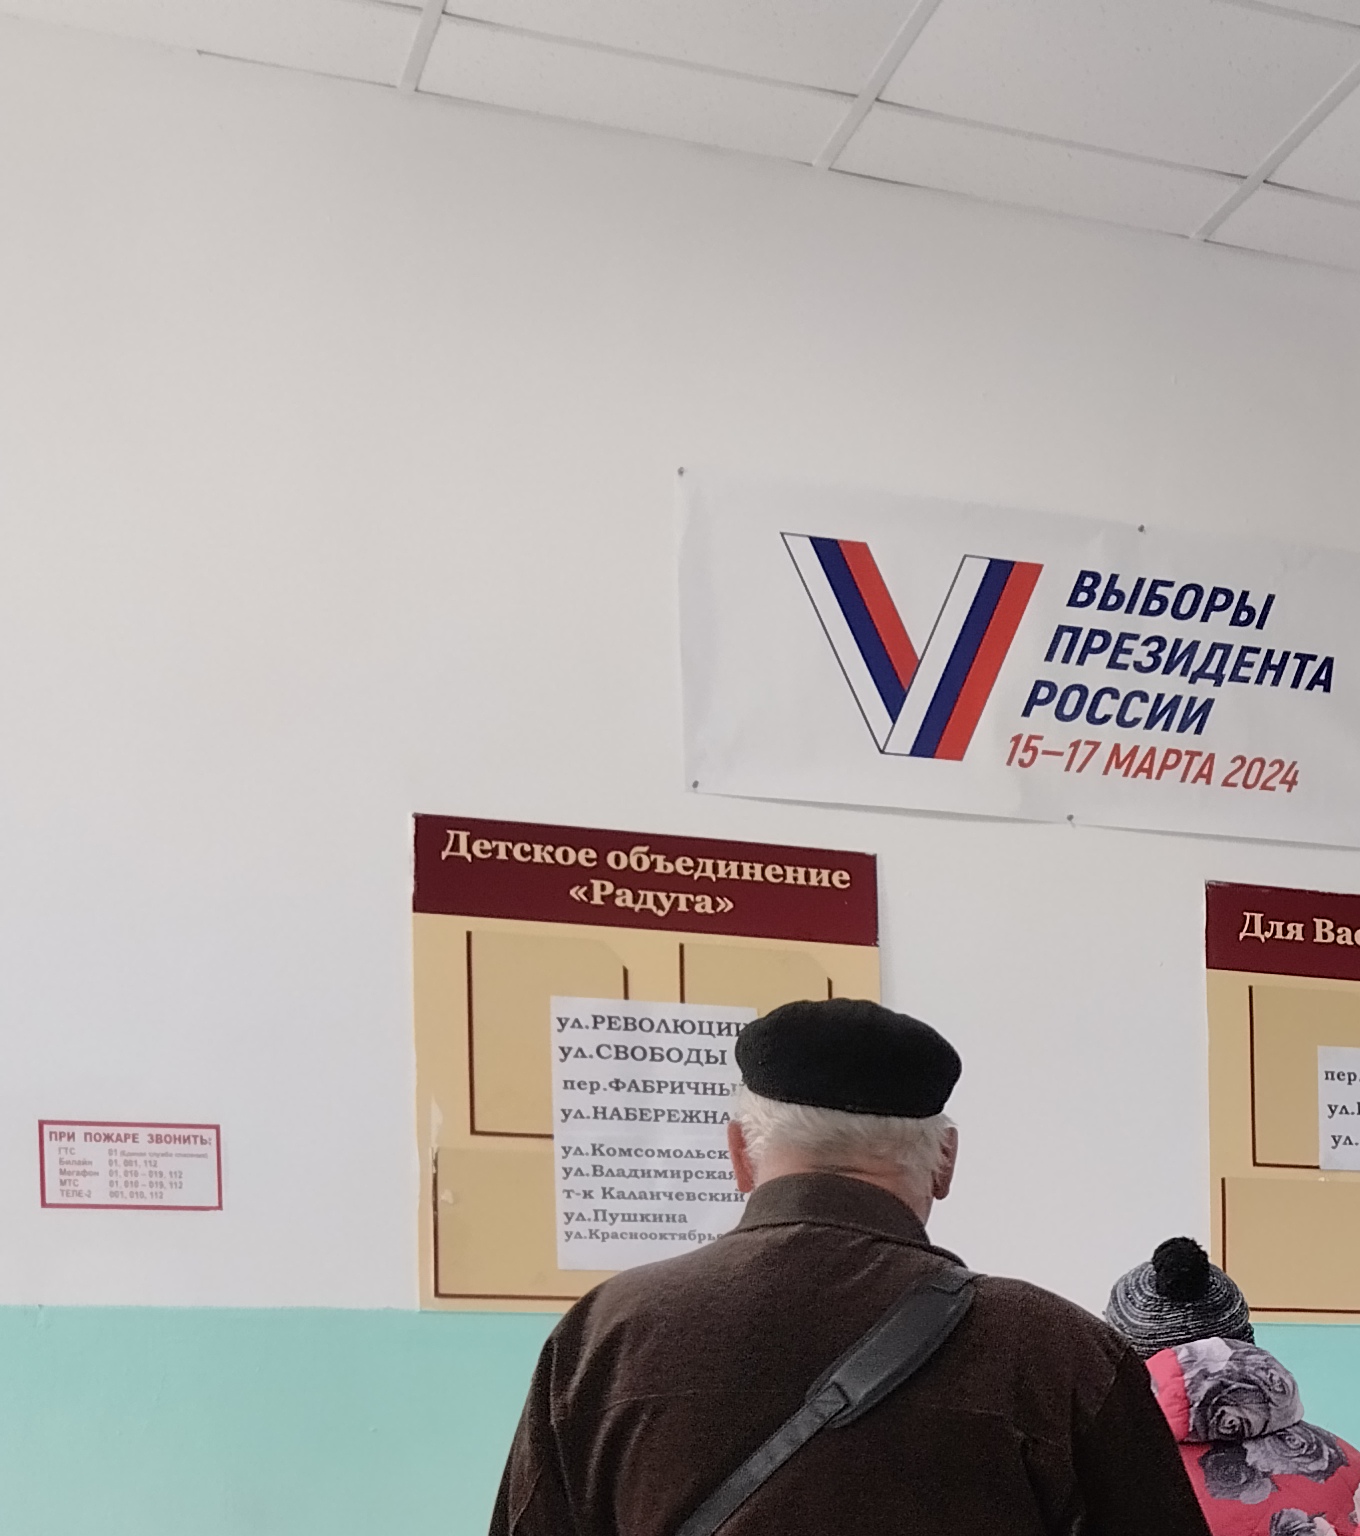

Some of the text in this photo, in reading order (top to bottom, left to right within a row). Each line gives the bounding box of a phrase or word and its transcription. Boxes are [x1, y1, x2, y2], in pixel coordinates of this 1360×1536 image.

[1066, 569, 1276, 630] ВЫБОРЫ
[1044, 624, 1335, 693] ПРЕЗИДЕНТА
[1021, 679, 1215, 736] РОССИИ
[1102, 742, 1215, 786] МАРТА
[1221, 754, 1300, 793] 2024
[441, 828, 852, 889] Детское объединение
[569, 879, 734, 917] «Радуга»
[1239, 911, 1304, 943] Для
[558, 1043, 727, 1067] ул.СВОБОДЫ
[562, 1077, 746, 1097] пер.ФАБРИЧНЫ
[560, 1105, 731, 1125] ул.НАБЕРЕЖНА
[49, 1130, 212, 1146] ПРИ ПОЖАРЕ ЗВОНИТЬ:
[561, 1143, 729, 1160] ул.Комсомольск
[562, 1186, 746, 1202] т-к Каланчевский
[563, 1208, 688, 1226] ул.Пушкина
